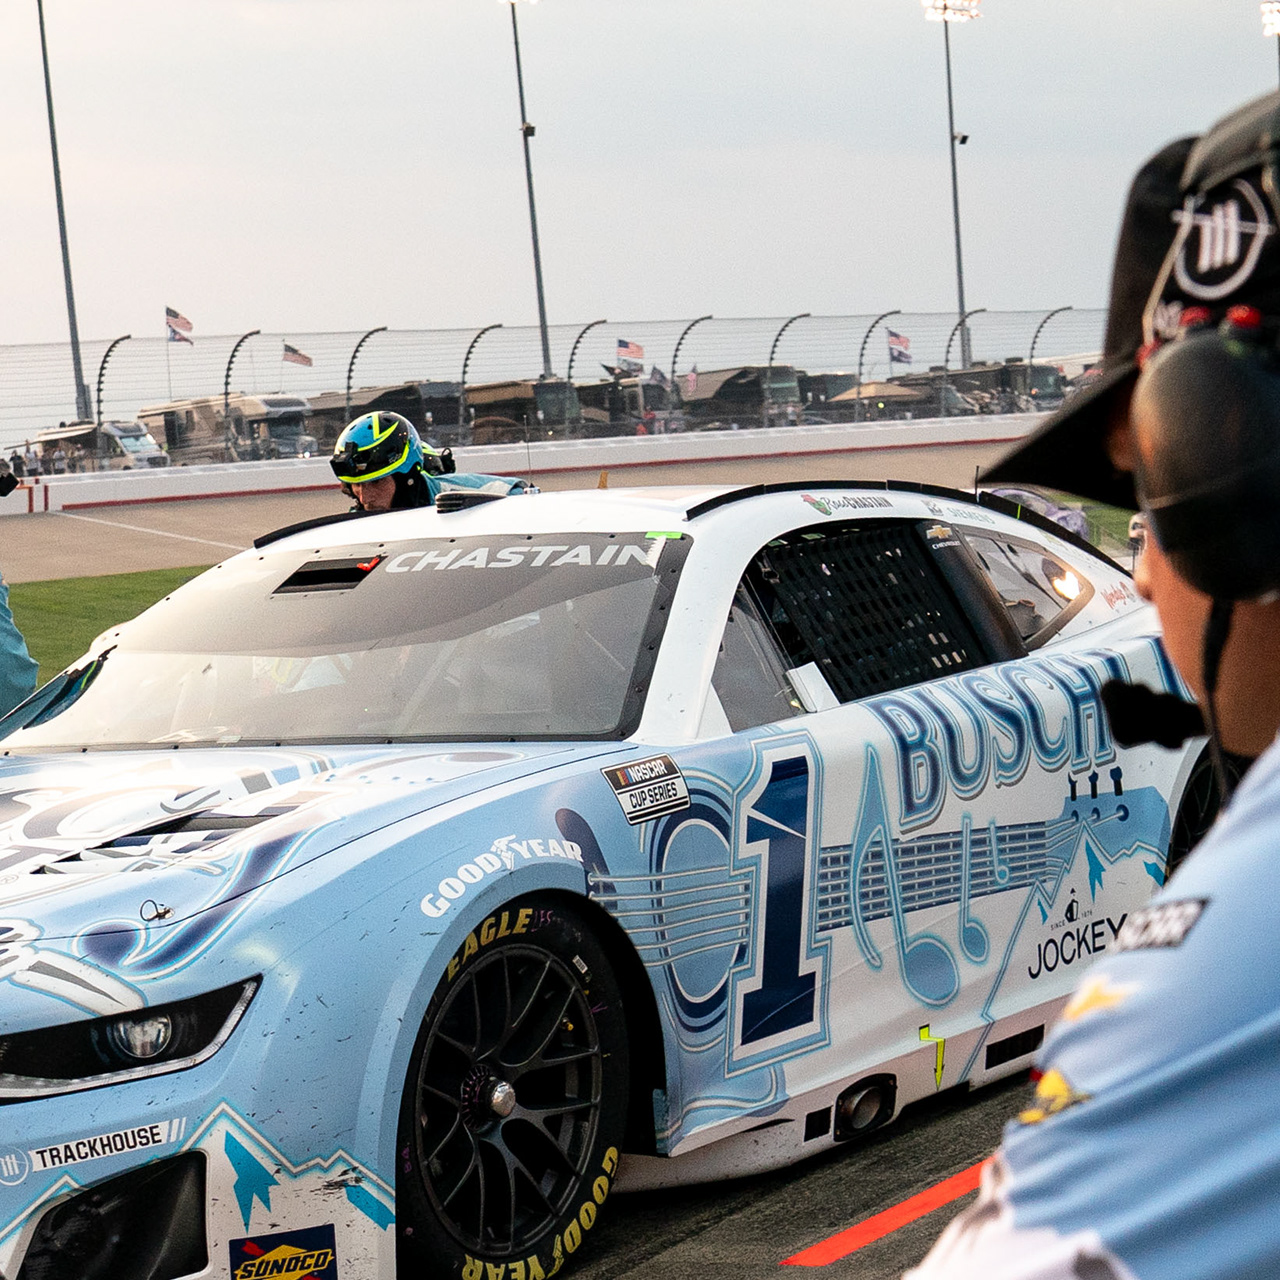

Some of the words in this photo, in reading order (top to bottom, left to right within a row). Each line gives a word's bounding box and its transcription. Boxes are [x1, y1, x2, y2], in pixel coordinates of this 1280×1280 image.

[385, 544, 655, 574] CHASTAIN
[862, 649, 1132, 836] BUSCH
[627, 759, 668, 783] NASCAR
[628, 786, 648, 809] CUP
[647, 781, 678, 804] SERIES
[734, 748, 820, 1060] 1
[446, 908, 533, 982] EAGLE
[1027, 912, 1129, 980] JOCKEY
[36, 1124, 162, 1169] TRACKHOUSE
[238, 1250, 333, 1280] SUNOCO
